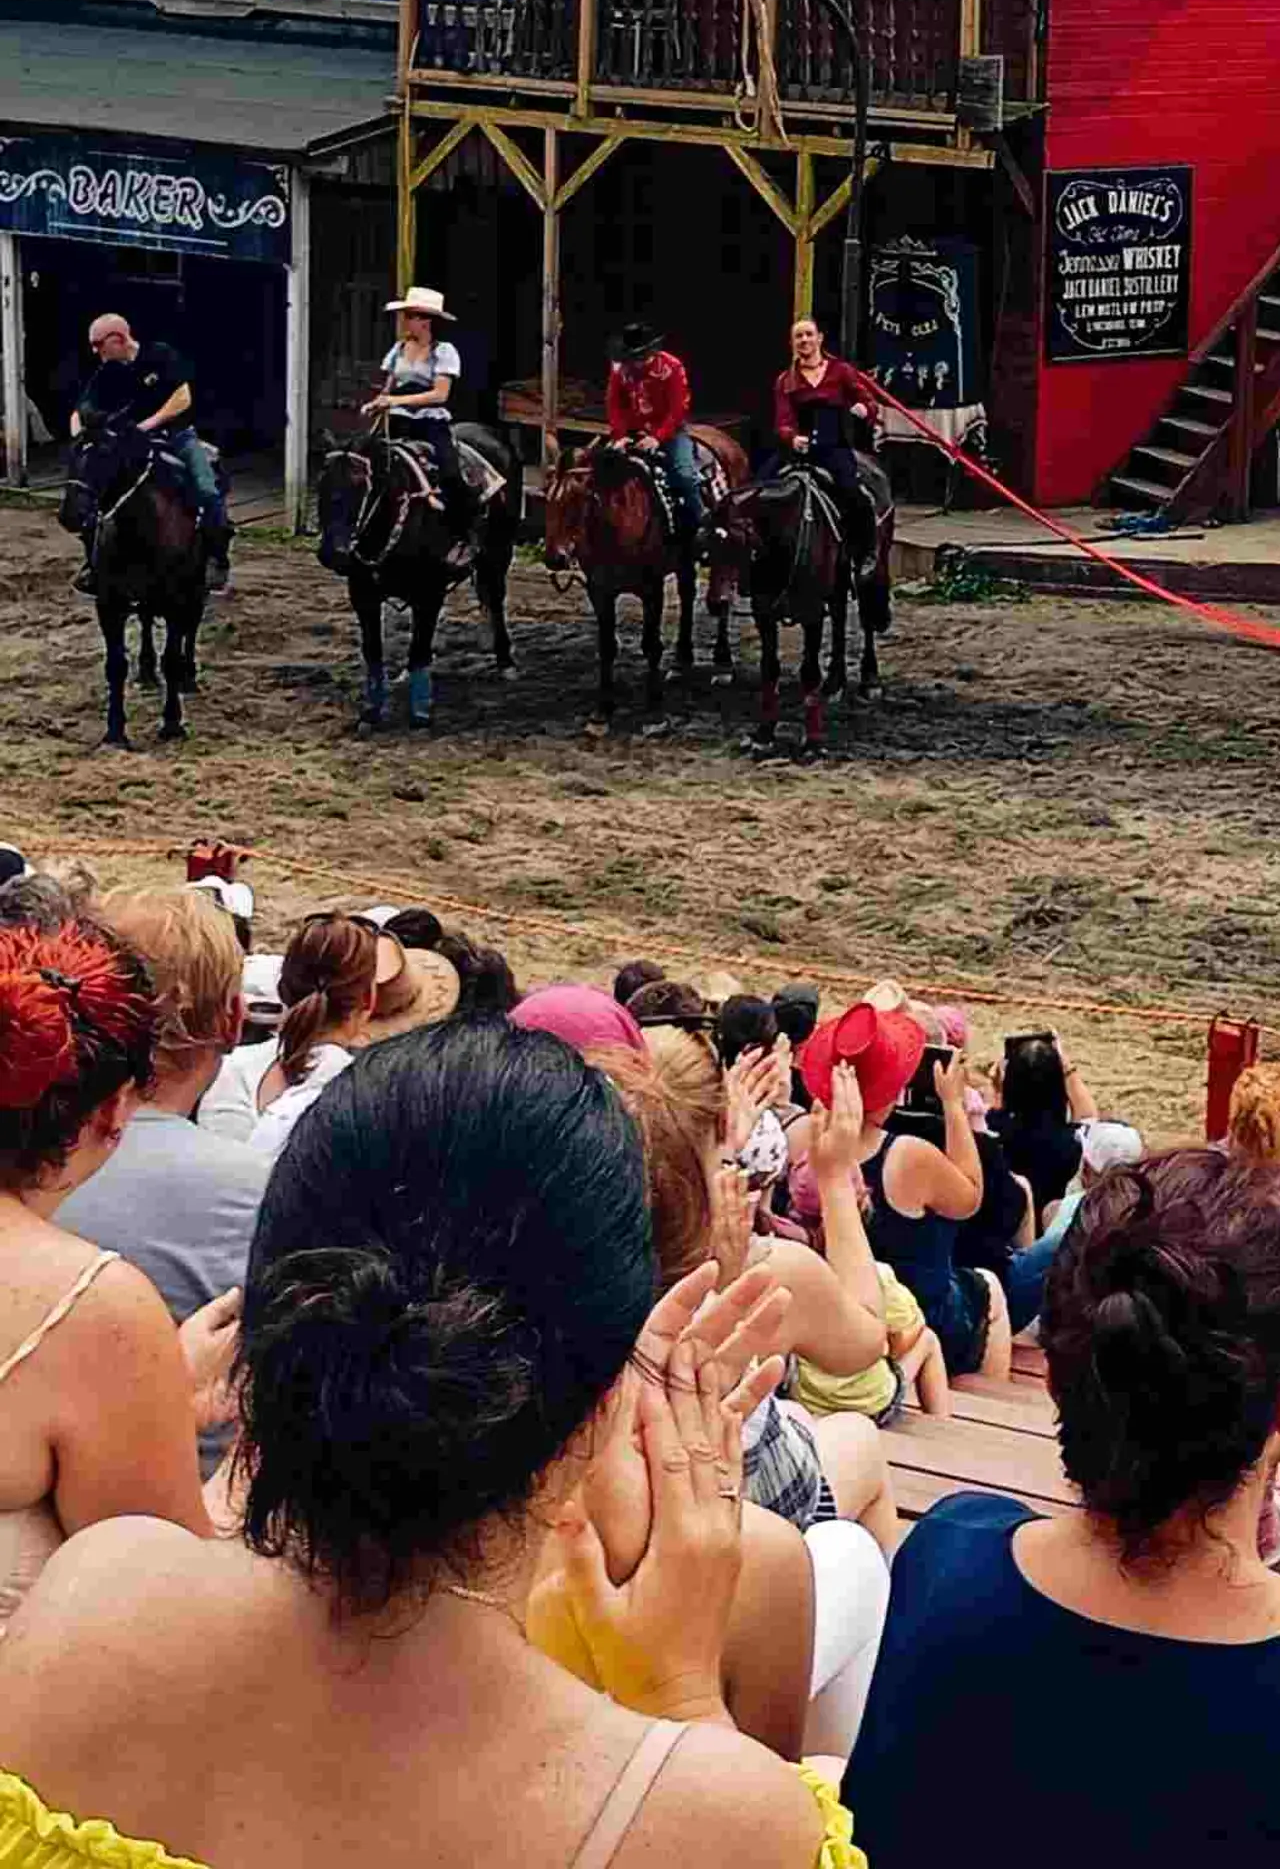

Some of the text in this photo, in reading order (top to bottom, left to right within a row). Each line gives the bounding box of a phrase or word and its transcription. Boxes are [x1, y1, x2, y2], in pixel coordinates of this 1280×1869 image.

[68, 165, 204, 230] BAKER
[1063, 190, 1175, 231] JACK DANIEL'S
[1122, 244, 1182, 271] WHISKEY
